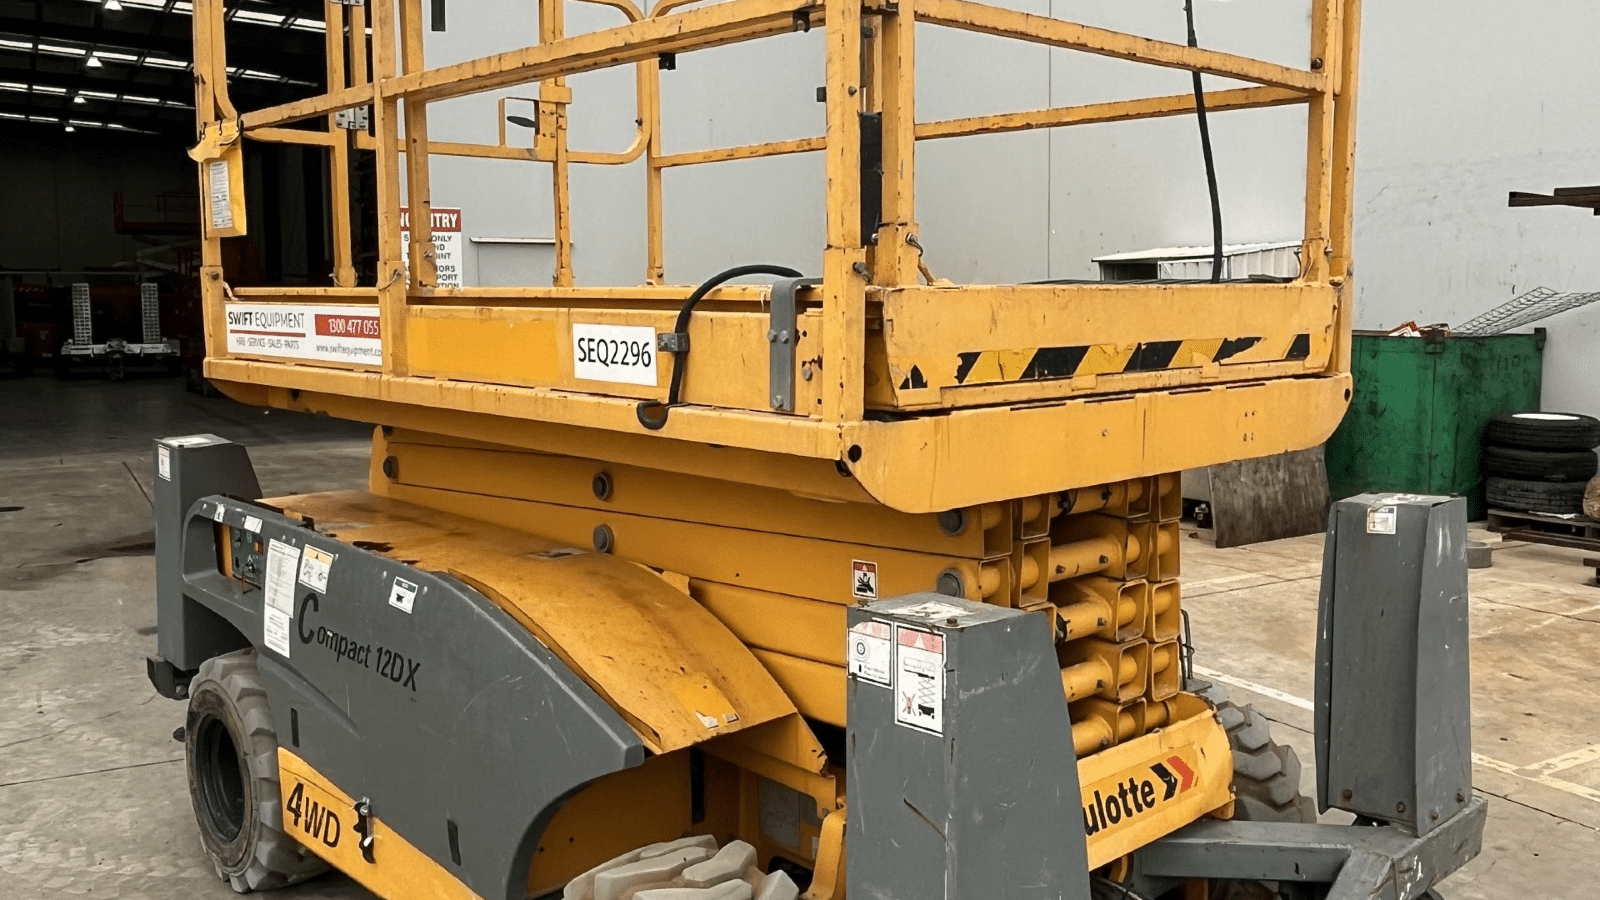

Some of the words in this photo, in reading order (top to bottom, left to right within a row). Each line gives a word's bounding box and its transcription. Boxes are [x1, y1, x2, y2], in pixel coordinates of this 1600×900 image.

[431, 213, 458, 228] TRY
[435, 252, 451, 260] INT
[437, 273, 458, 281] PORT
[229, 311, 253, 326] SWIFT
[255, 312, 305, 330] EQUIPMENT
[328, 318, 346, 334] 1300
[347, 319, 362, 334] 477
[363, 320, 379, 336] 055
[577, 337, 652, 368] SEQ2296
[299, 592, 372, 668] Compact
[376, 646, 421, 692] 12DX
[286, 782, 340, 848] 4WD
[1082, 777, 1156, 837] ulotte
